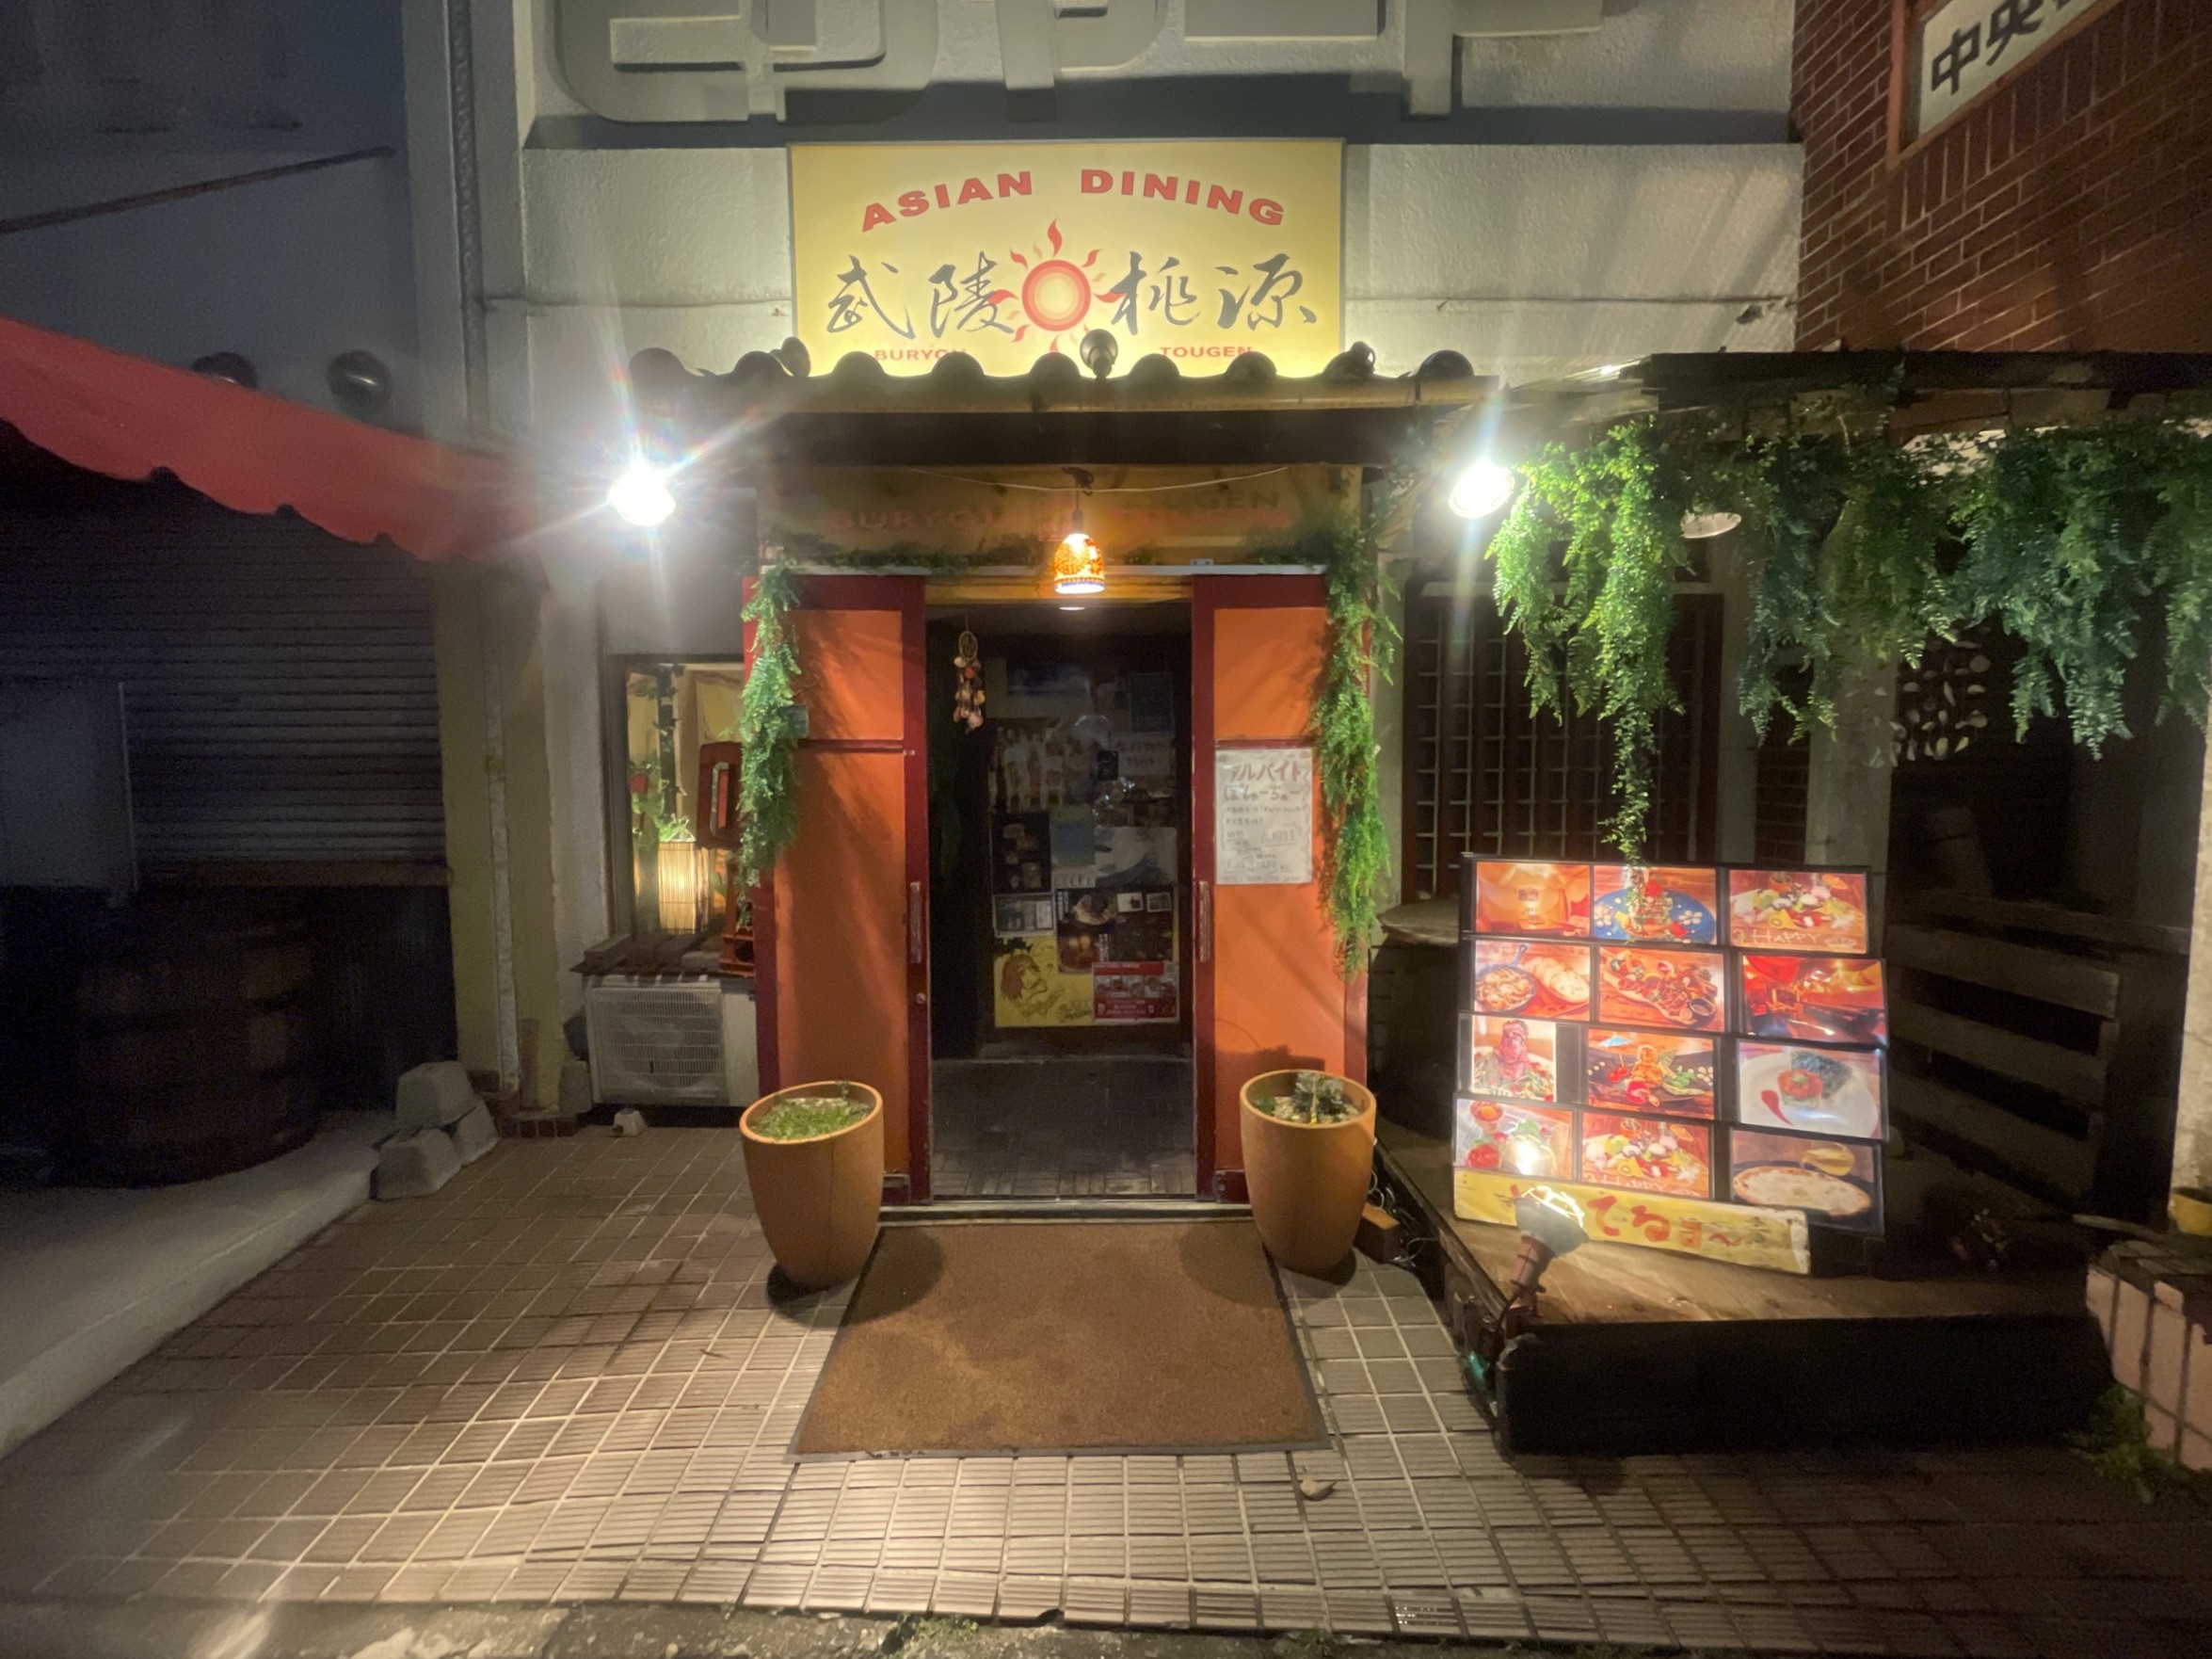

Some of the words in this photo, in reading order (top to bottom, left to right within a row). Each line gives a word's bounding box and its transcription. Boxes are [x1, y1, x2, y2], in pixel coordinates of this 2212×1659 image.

[1931, 0, 2073, 95] 中央
[862, 170, 1033, 233] ASIAN
[1081, 169, 1285, 226] DINING
[826, 250, 1015, 340] 武陵
[1109, 250, 1317, 336] 桃源
[1229, 761, 1301, 783] アルバイト
